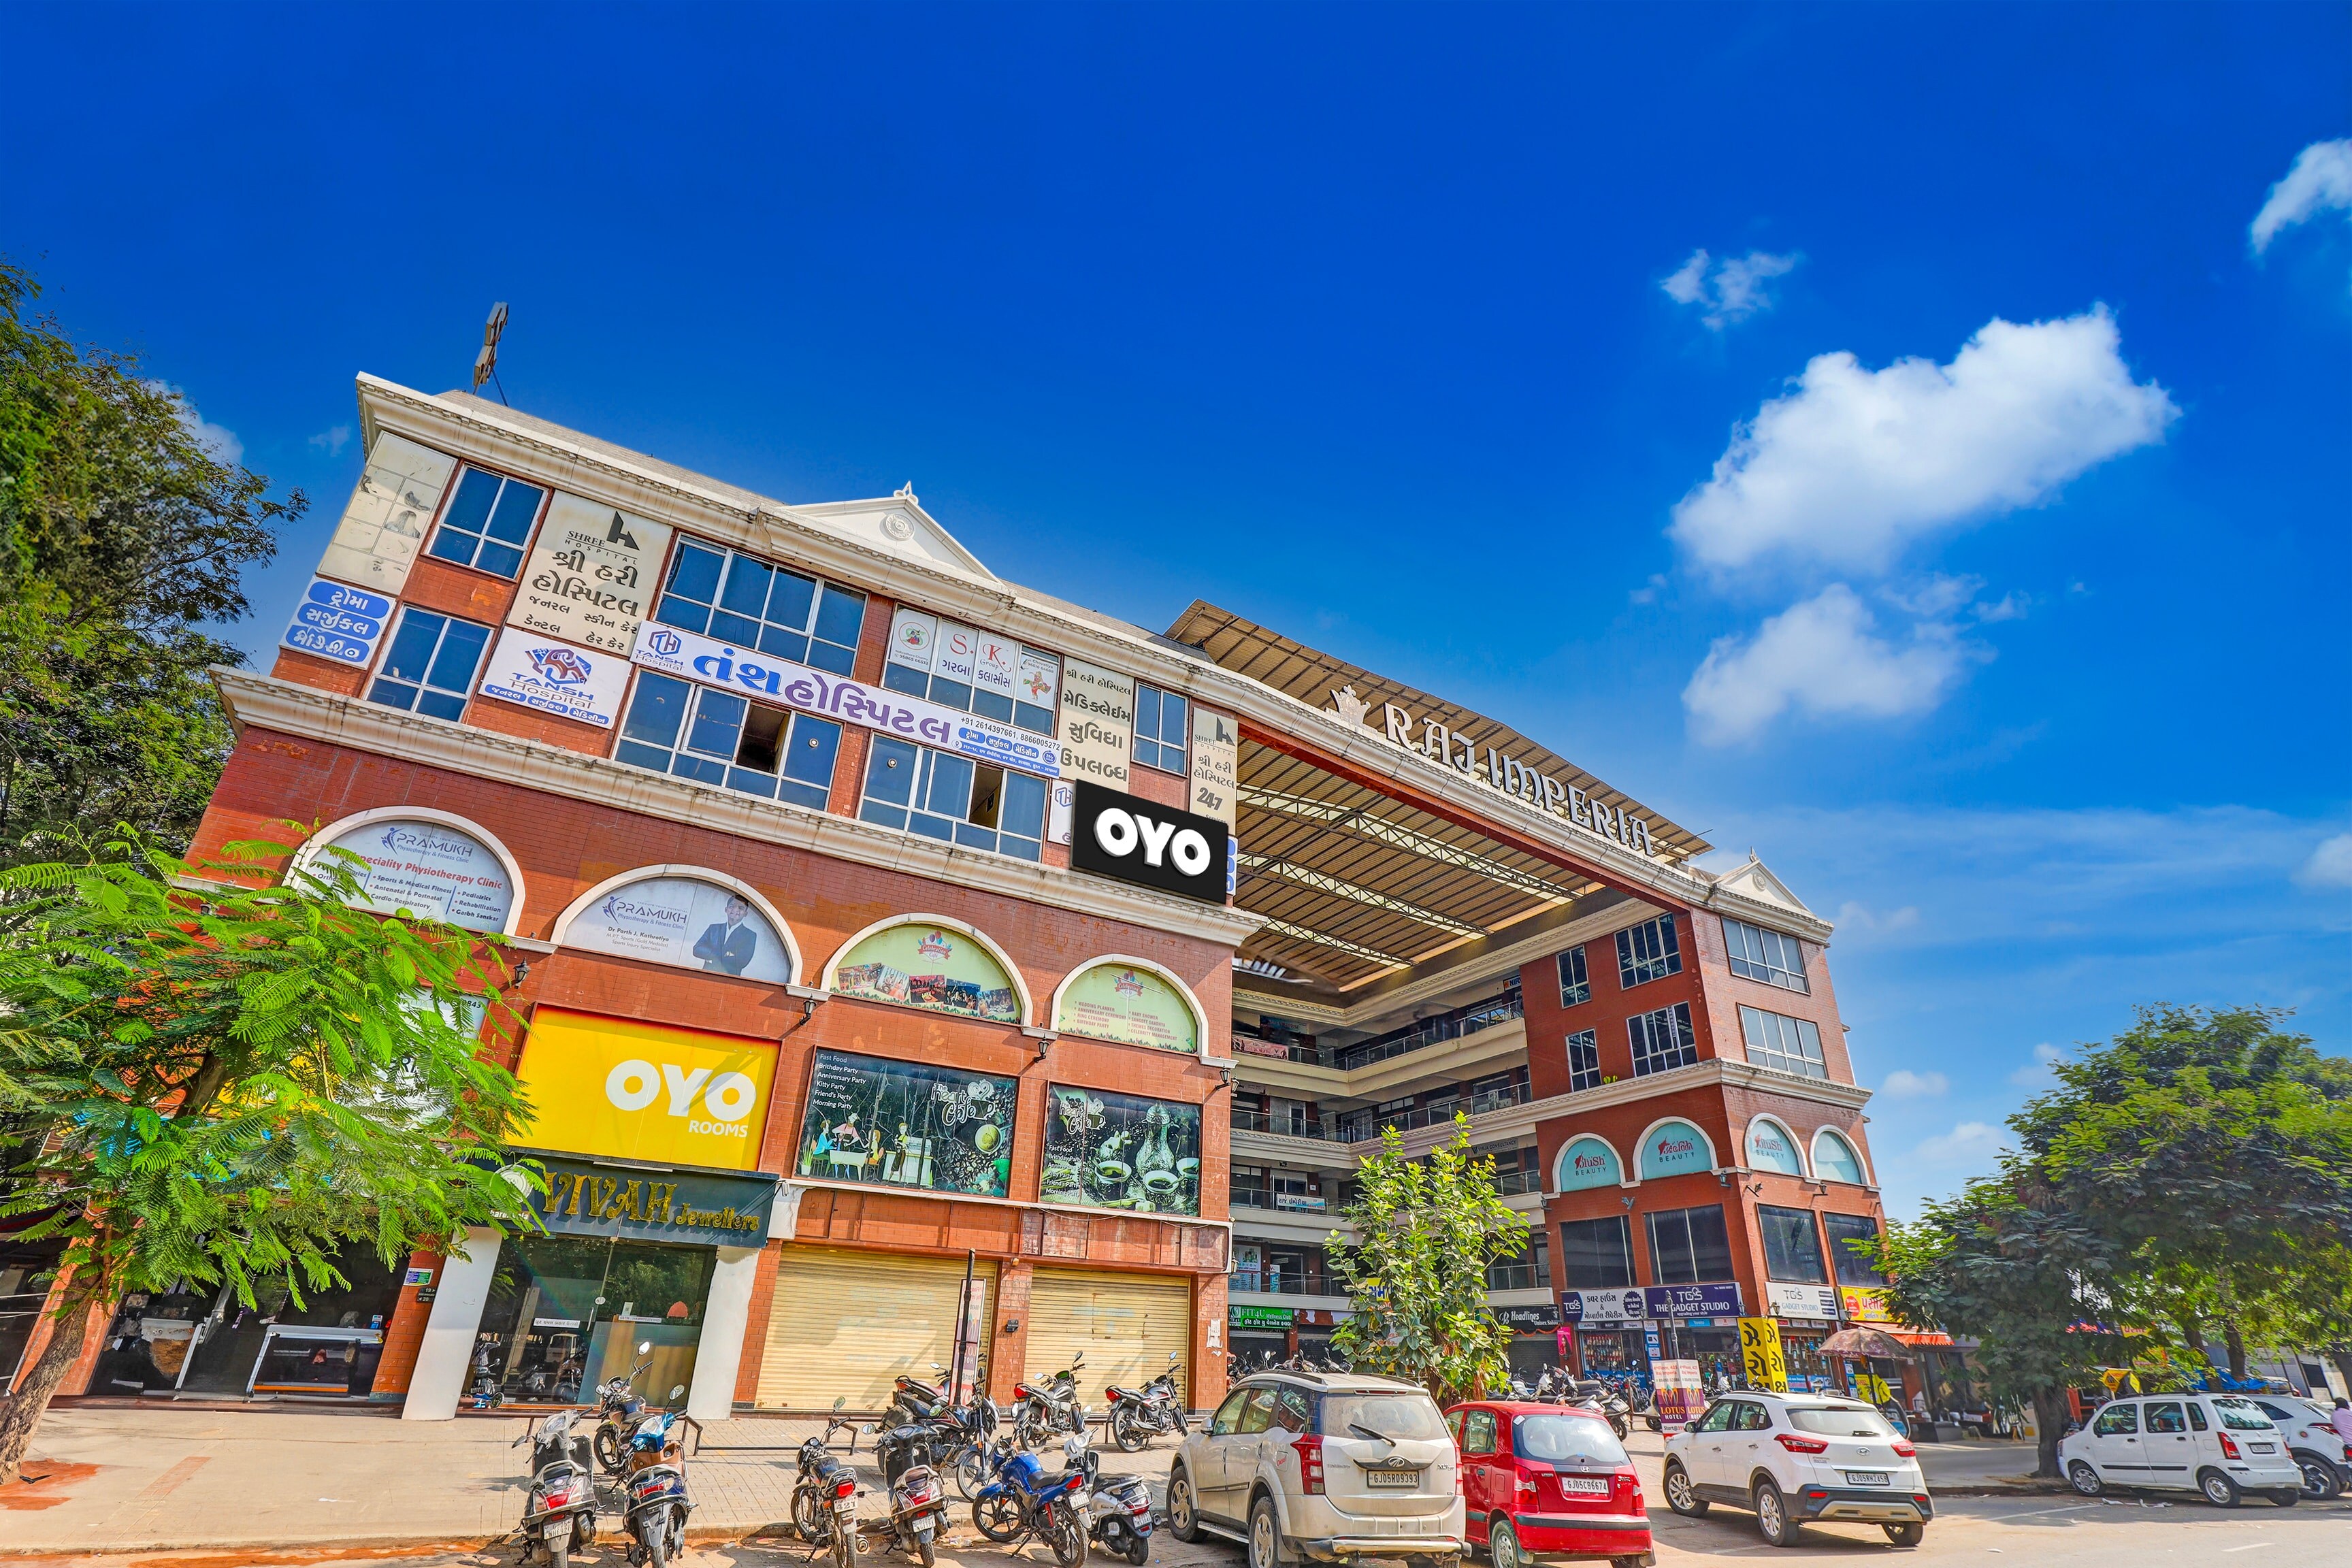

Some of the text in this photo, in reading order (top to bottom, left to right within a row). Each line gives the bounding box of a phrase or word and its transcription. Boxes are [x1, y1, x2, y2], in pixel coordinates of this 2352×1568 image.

[568, 530, 606, 547] SHREE
[565, 540, 637, 565] HOSPITAL
[552, 549, 638, 589] શ્રી હરી
[328, 588, 369, 610] ટ્રોમા
[532, 570, 638, 617] હોસ્પિટલ
[529, 595, 570, 614] જનરલ
[524, 614, 561, 633] ડેન્ટલ
[584, 613, 638, 634] સ્કીન કેર
[586, 632, 625, 651] હેર કેર
[634, 655, 684, 671] Hospital
[636, 649, 684, 666] TANSH
[979, 658, 999, 670] Group
[941, 659, 970, 676] ગરબા
[512, 672, 594, 700] TANSH
[1066, 669, 1131, 696] શ્રી હરી હોસ્પિટલ
[511, 681, 591, 709] Hospital
[491, 687, 521, 700] જનરલ
[572, 708, 606, 723] મેડિસીન
[961, 717, 1060, 751] +91 2614397661, 8866005272
[1068, 721, 1122, 749] સુવિધા
[1194, 734, 1216, 745] SHREE
[966, 729, 979, 740] ટ્રોમા
[1015, 745, 1036, 757] મેડિસીન
[1194, 742, 1236, 758] HOSPITAL
[1060, 747, 1127, 783] ઉપલબ્ધ
[1198, 755, 1231, 774] શ્રી હરી
[1193, 766, 1235, 789] હોસ્પિટલ
[1383, 702, 1652, 856] RAJ IMPERIA
[397, 833, 473, 857] PRAMUKH
[397, 844, 431, 856] Physiotherapy
[1093, 808, 1211, 877] OYO
[377, 875, 397, 883] Sports
[406, 881, 430, 889] Medical
[431, 885, 452, 894] Fitness
[405, 863, 502, 889] Physiotherapy Clinic
[371, 894, 430, 909] Cardio-Respiratory
[374, 885, 406, 894] Antenatal
[414, 892, 442, 901] Postnatal
[462, 892, 491, 901] Pediatrics
[459, 900, 501, 913] Rehabilitation
[617, 902, 687, 924] PRAMUKH
[476, 913, 499, 921] Sanskar
[617, 913, 649, 924] Physiotherapy
[640, 932, 669, 942] Kathrotiya
[1078, 1008, 1105, 1016] ANNIVERSARY
[1152, 1032, 1177, 1041] MANAGEMENT
[819, 1063, 843, 1072] Brithday
[817, 1072, 851, 1082] Anniversary
[605, 1059, 757, 1122] OYO
[813, 1099, 836, 1108] Morning
[688, 1120, 749, 1138] ROOMS
[1659, 1152, 1695, 1162] BEAUTY
[1756, 1150, 1784, 1159] BEAUTY
[1575, 1167, 1606, 1176] BEAUTY
[543, 1172, 680, 1223] VIVAH
[674, 1203, 760, 1231] Jewellers
[1600, 1292, 1616, 1302] હાઉસ
[1677, 1288, 1703, 1303] TGS
[1783, 1288, 1803, 1300] TGS
[1242, 1309, 1265, 1318] FIT4U
[1564, 1300, 1581, 1310] TGS
[1654, 1301, 1729, 1312] THE GADGET STUDIO
[1511, 1311, 1540, 1322] Headlines
[1584, 1311, 1603, 1319] મોબાઈલ
[1661, 1406, 1686, 1414] LOTUS
[1374, 1473, 1418, 1484] GJ05RD9393
